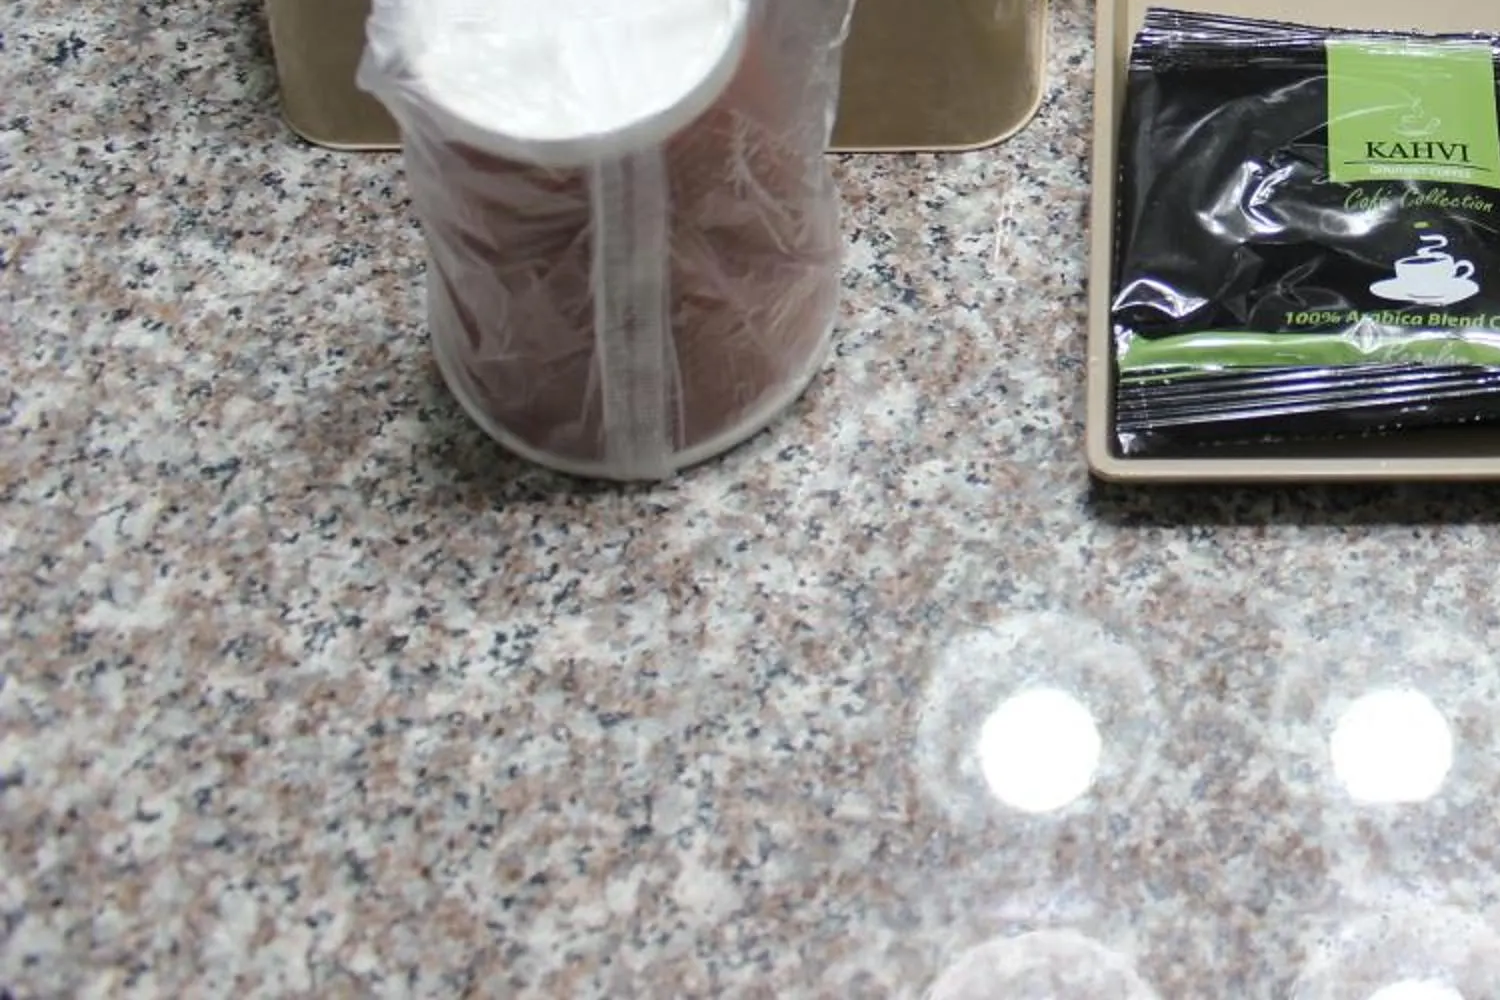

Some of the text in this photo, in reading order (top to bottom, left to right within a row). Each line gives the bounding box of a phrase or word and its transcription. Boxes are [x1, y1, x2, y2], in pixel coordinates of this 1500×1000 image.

[1366, 141, 1471, 163] KAHVI
[1400, 188, 1494, 212] Collection
[1285, 311, 1341, 326] 100%
[1428, 313, 1484, 328] Blend
